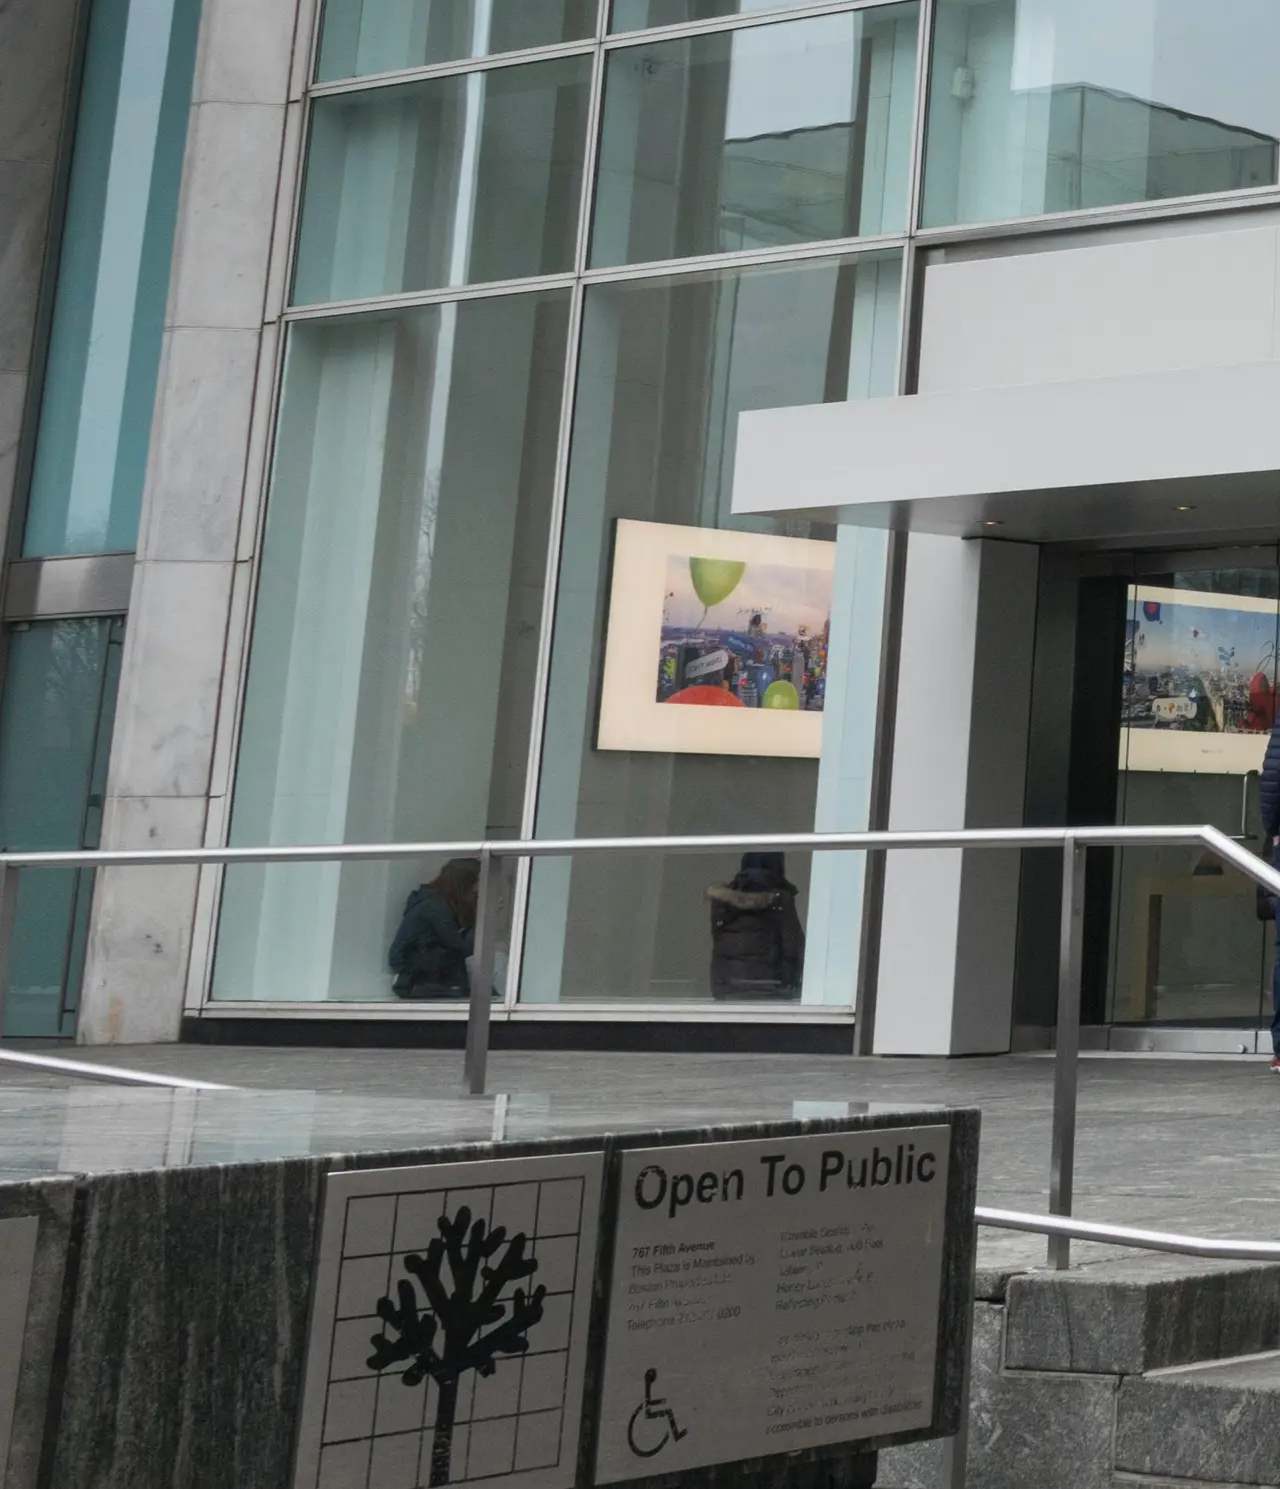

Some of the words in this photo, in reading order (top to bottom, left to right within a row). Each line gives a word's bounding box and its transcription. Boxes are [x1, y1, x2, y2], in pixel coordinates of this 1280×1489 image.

[634, 1164, 744, 1218] Open
[760, 1155, 806, 1197] To
[819, 1143, 936, 1192] Public
[632, 1246, 650, 1258] 767
[653, 1243, 675, 1256] Fifth
[677, 1239, 715, 1253] Avenue
[630, 1264, 651, 1277] This
[653, 1260, 680, 1273] Plaza
[682, 1259, 690, 1270] is
[693, 1253, 743, 1269] Maintained
